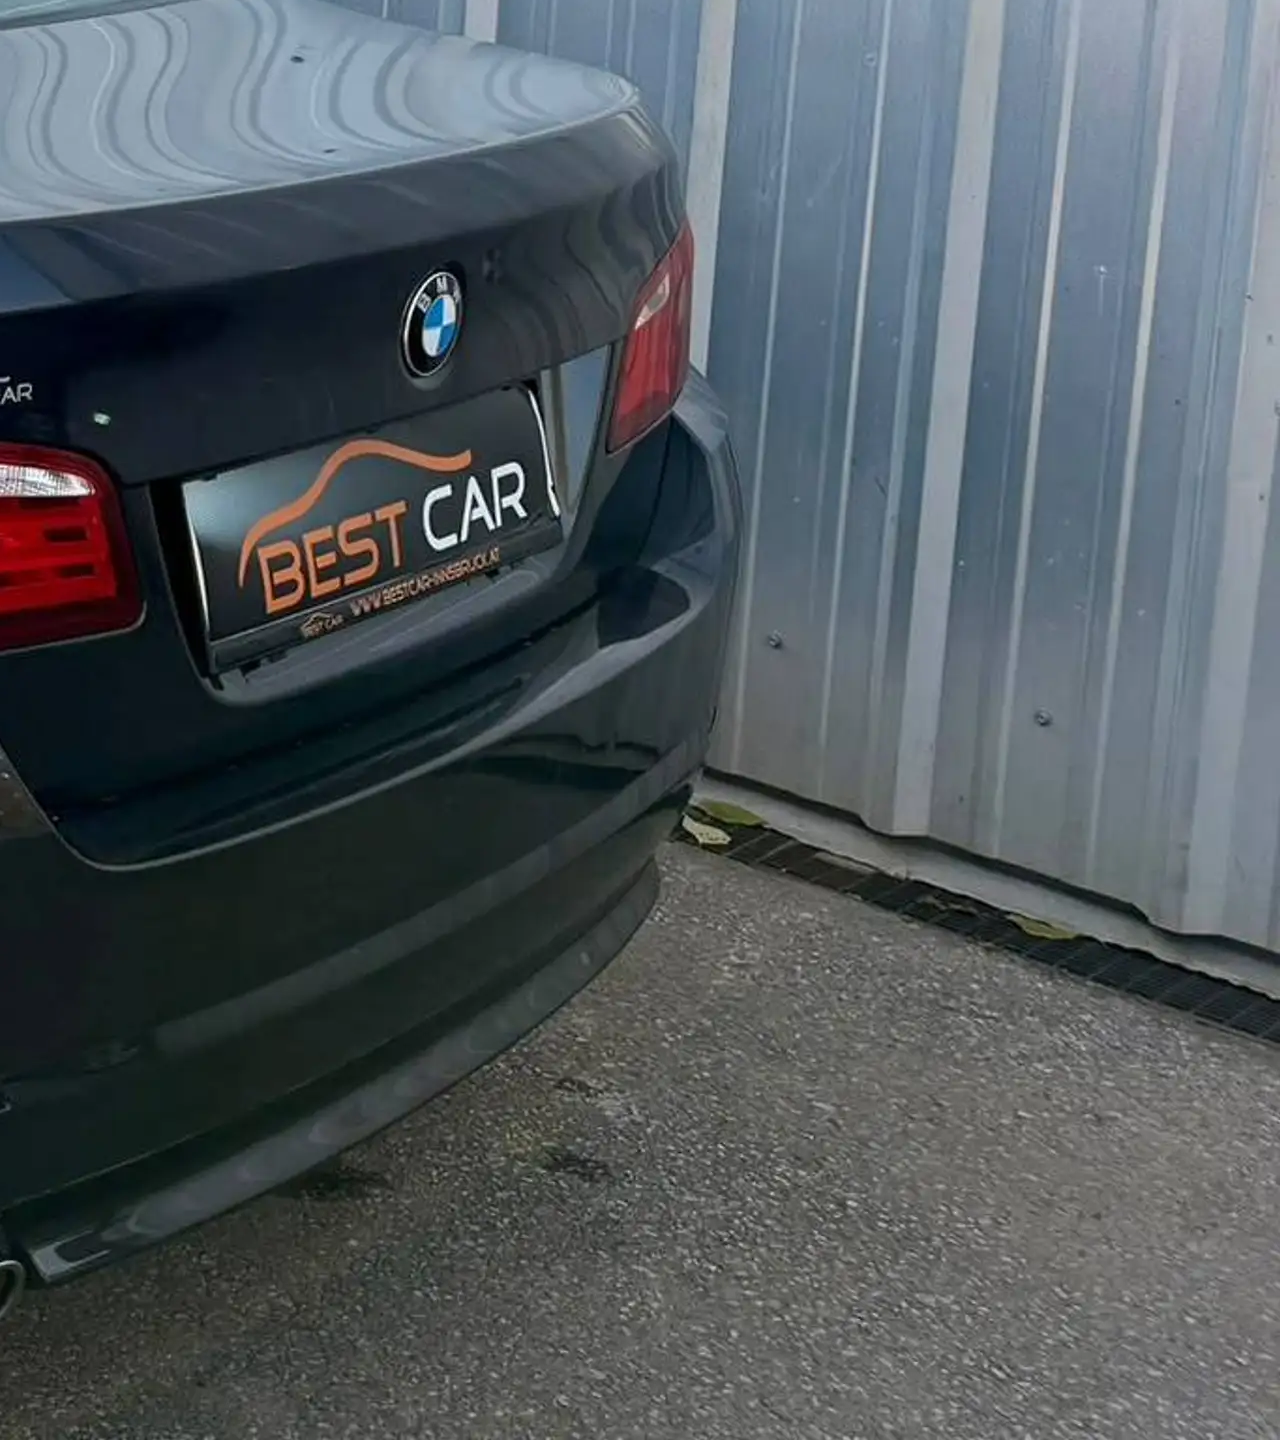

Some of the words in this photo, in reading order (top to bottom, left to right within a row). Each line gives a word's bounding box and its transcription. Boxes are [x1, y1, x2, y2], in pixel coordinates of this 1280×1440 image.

[416, 275, 461, 314] BMW
[257, 500, 408, 615] BEST
[422, 461, 528, 551] CAR
